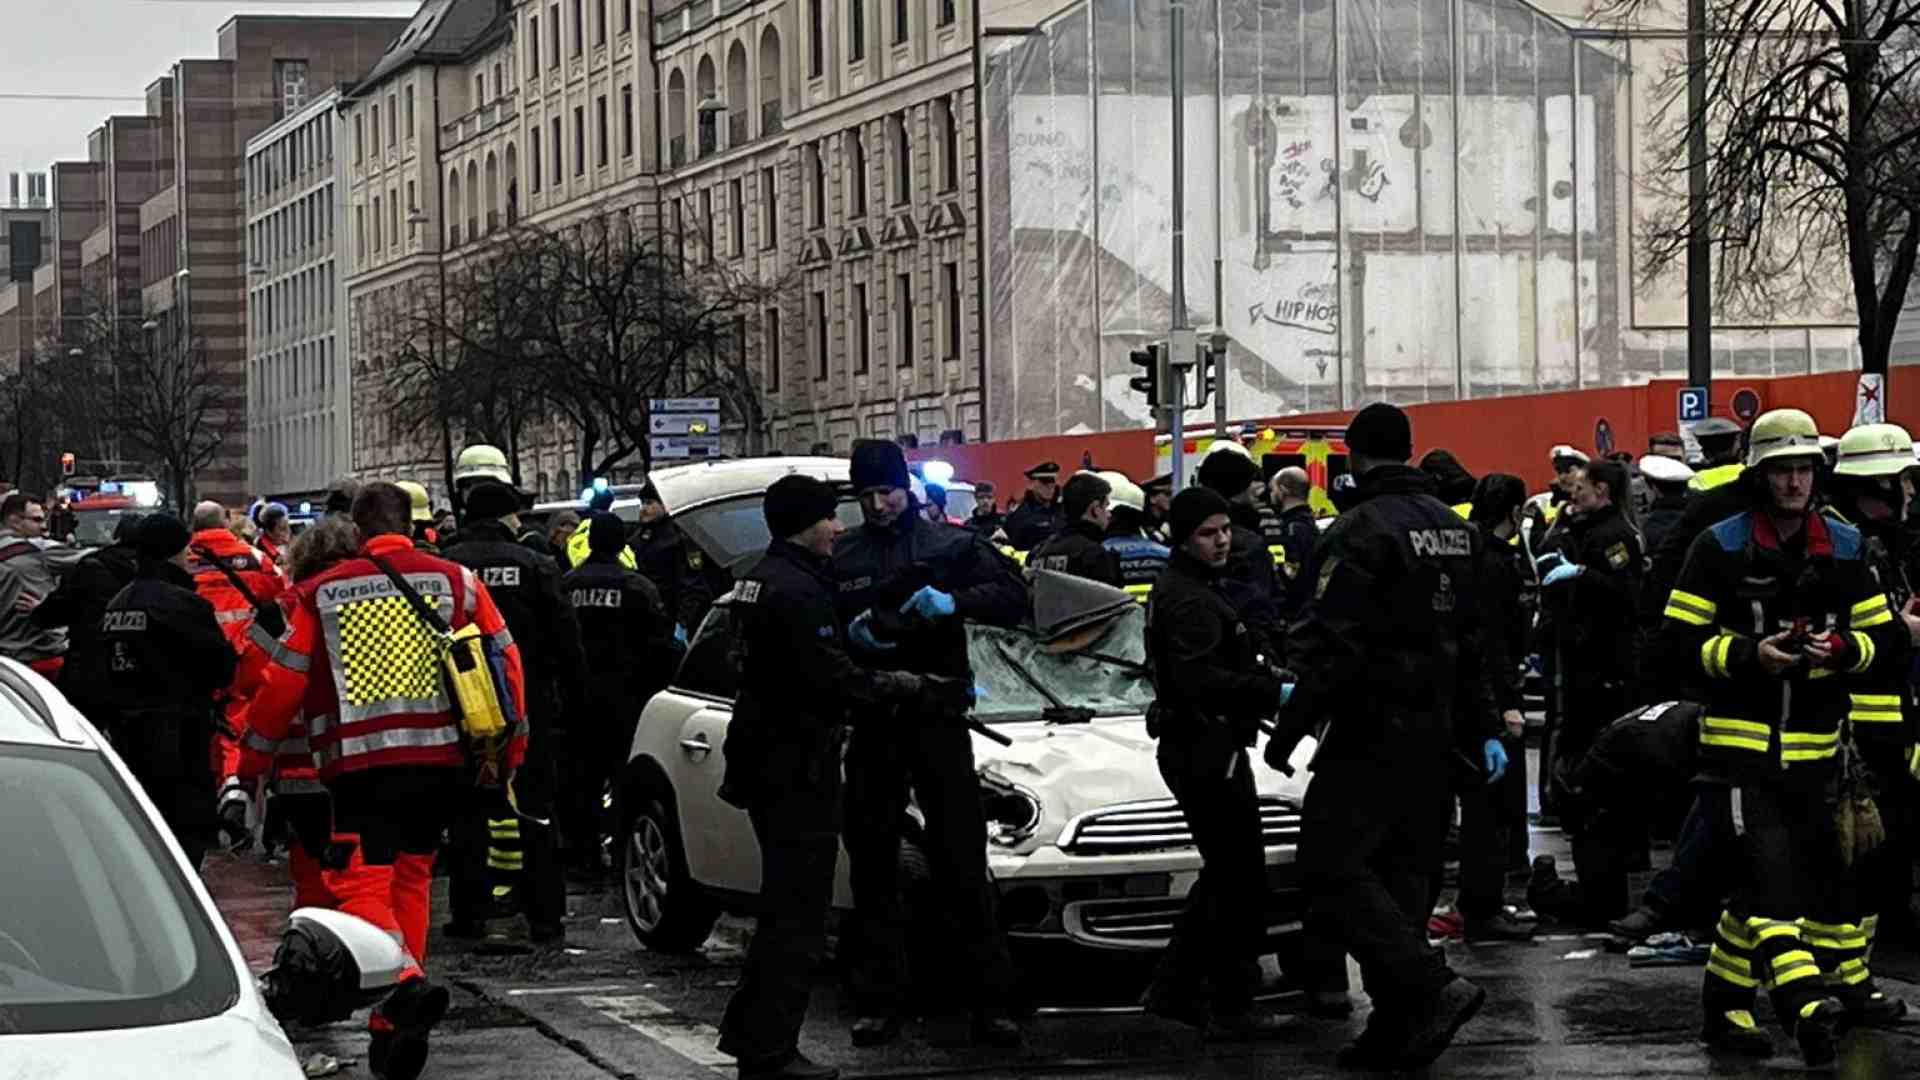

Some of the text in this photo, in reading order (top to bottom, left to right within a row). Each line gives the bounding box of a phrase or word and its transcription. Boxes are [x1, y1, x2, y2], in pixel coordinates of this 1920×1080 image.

[1683, 392, 1698, 418] P
[1409, 529, 1471, 557] POLIZEI
[569, 588, 622, 608] OLIZEI
[103, 610, 147, 632] POLIZEI
